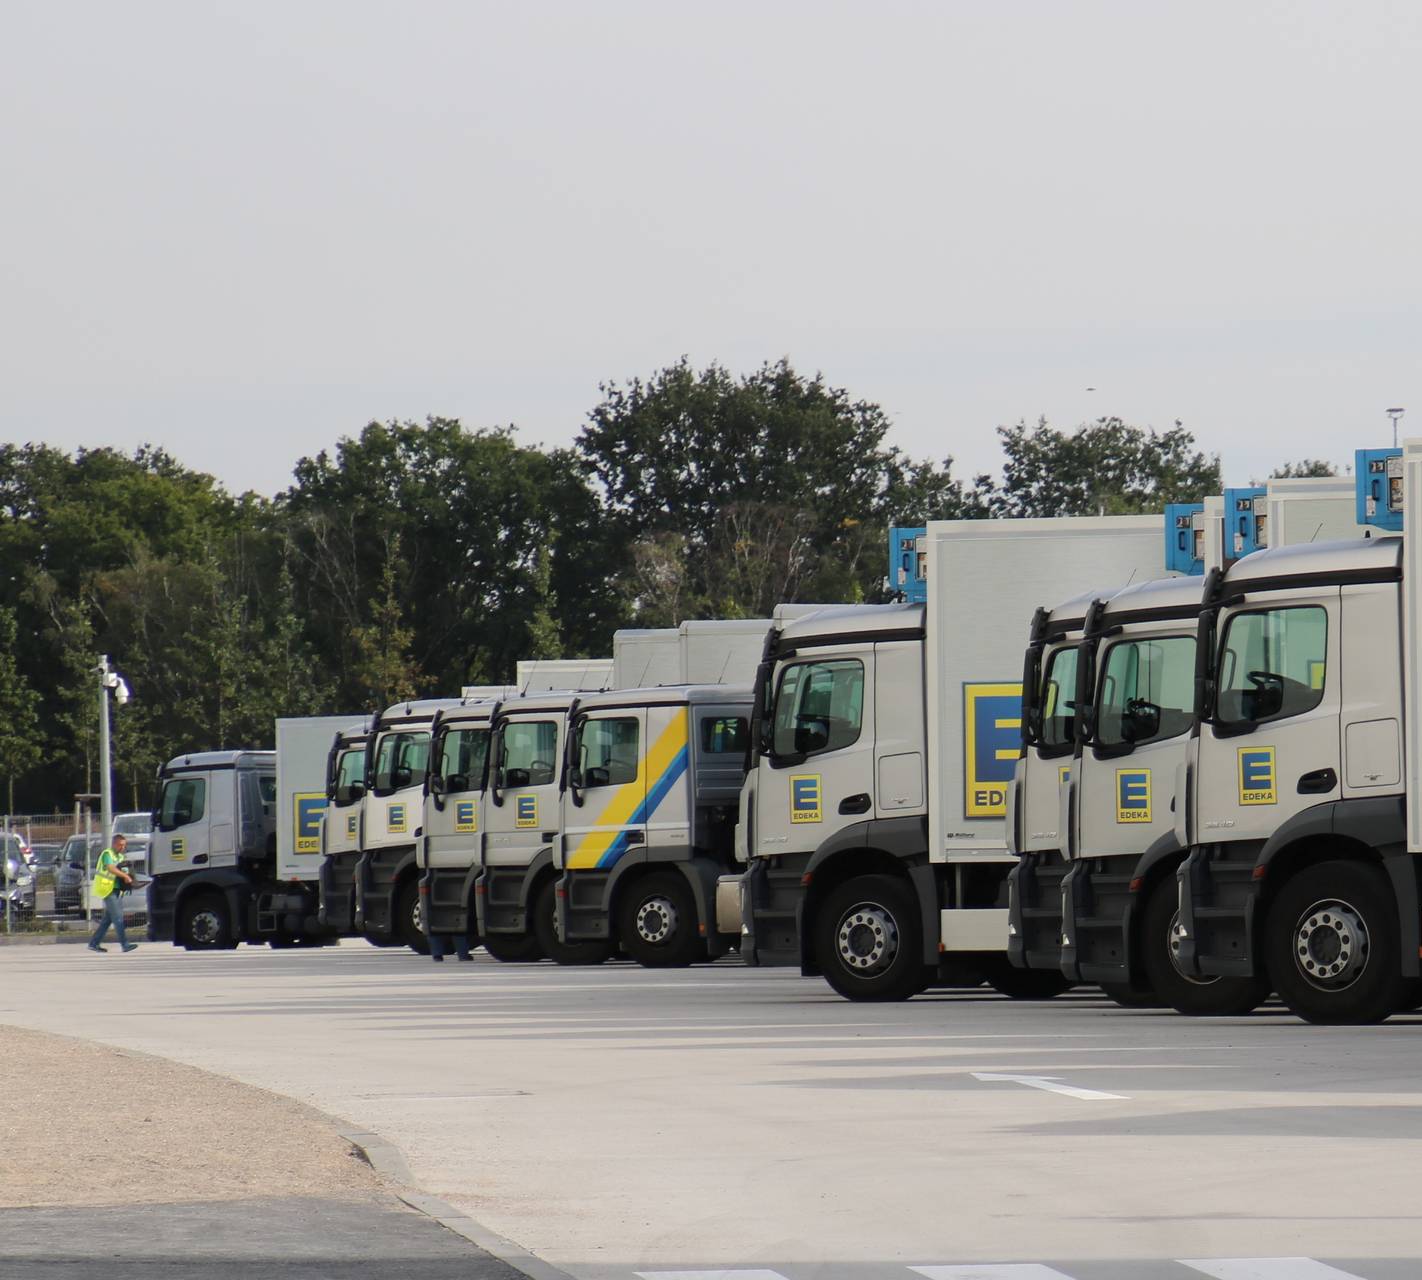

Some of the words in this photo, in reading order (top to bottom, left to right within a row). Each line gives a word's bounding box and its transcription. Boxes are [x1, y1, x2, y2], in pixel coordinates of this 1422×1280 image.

[974, 696, 1024, 783] E
[1242, 752, 1271, 790] E
[793, 779, 818, 810] E
[975, 790, 1007, 806] ED
[1120, 774, 1147, 809] E
[1242, 792, 1273, 800] EDEKA
[388, 806, 404, 825] E
[457, 803, 474, 824] E
[517, 797, 535, 819] E
[793, 812, 819, 820] EDEKA
[1120, 811, 1148, 819] EDEKA
[171, 839, 183, 855] E
